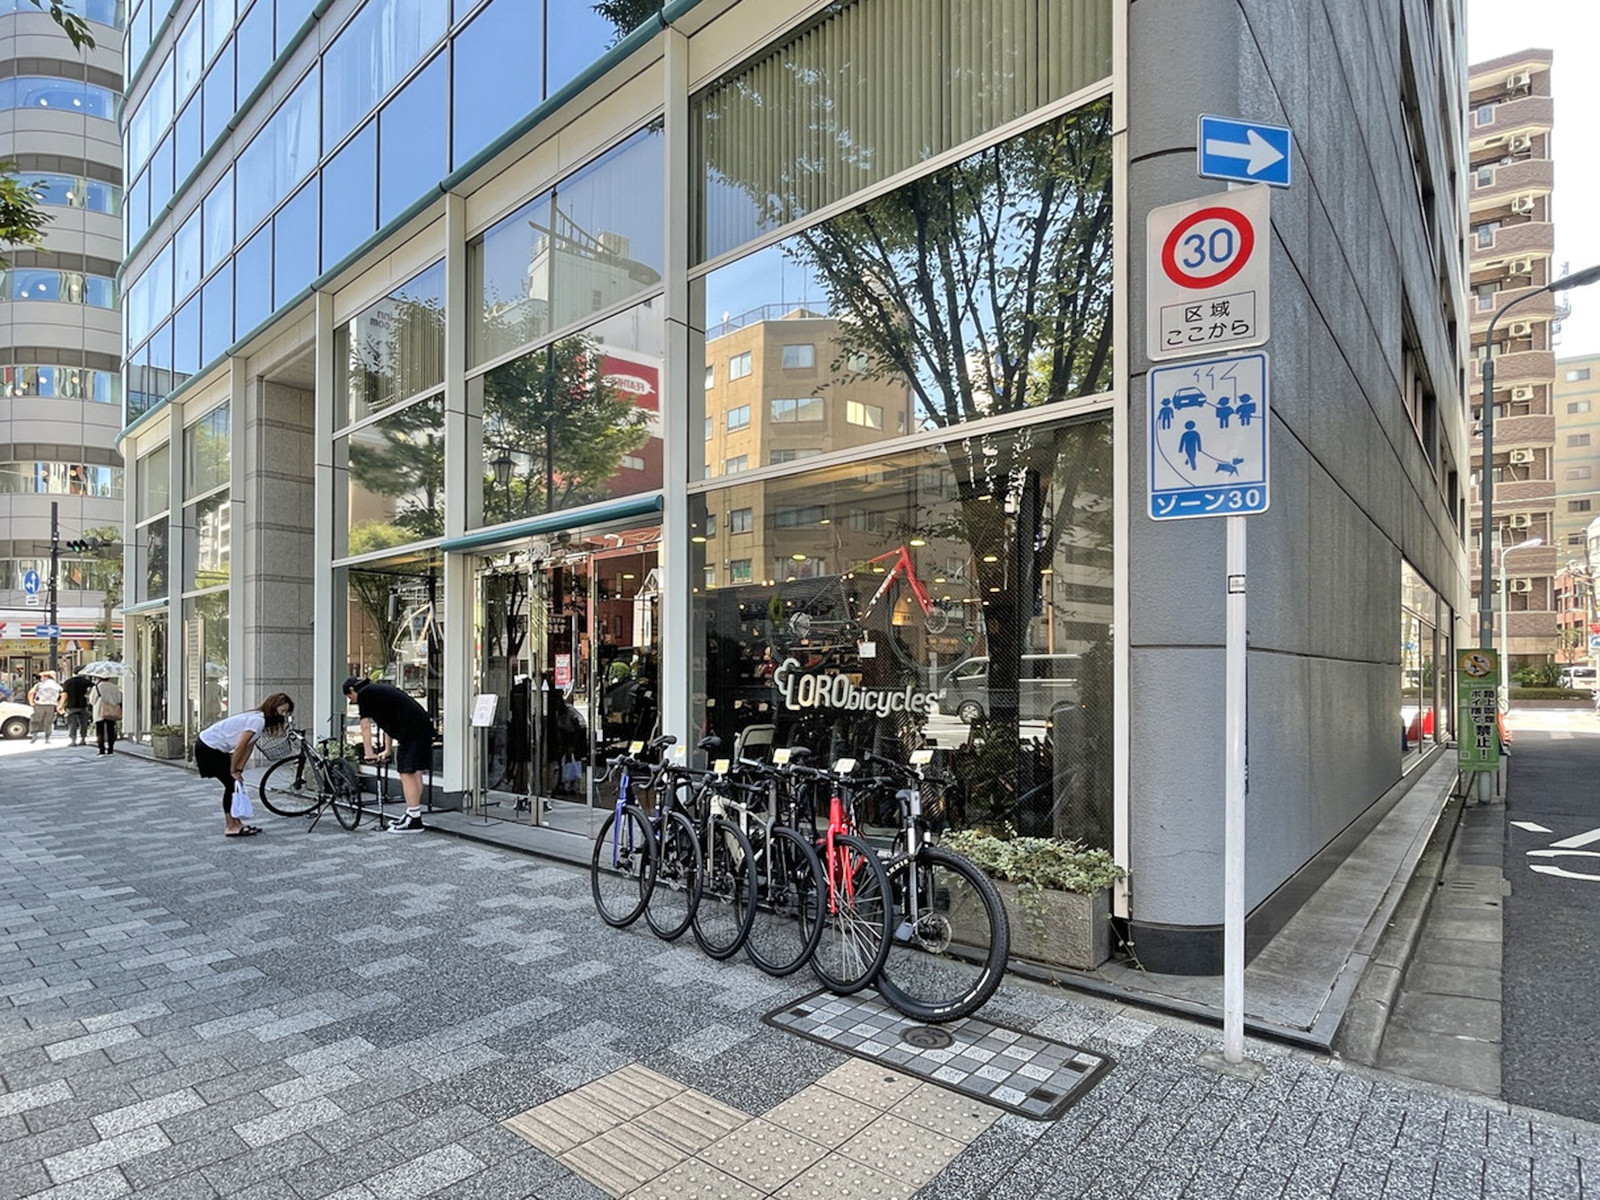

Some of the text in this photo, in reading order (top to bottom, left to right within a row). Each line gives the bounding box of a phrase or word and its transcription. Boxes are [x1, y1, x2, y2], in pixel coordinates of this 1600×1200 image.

[1183, 228, 1233, 268] 30
[1185, 301, 1230, 322] 区域
[1167, 319, 1250, 345] ここから
[1157, 489, 1261, 515] ゾーン30
